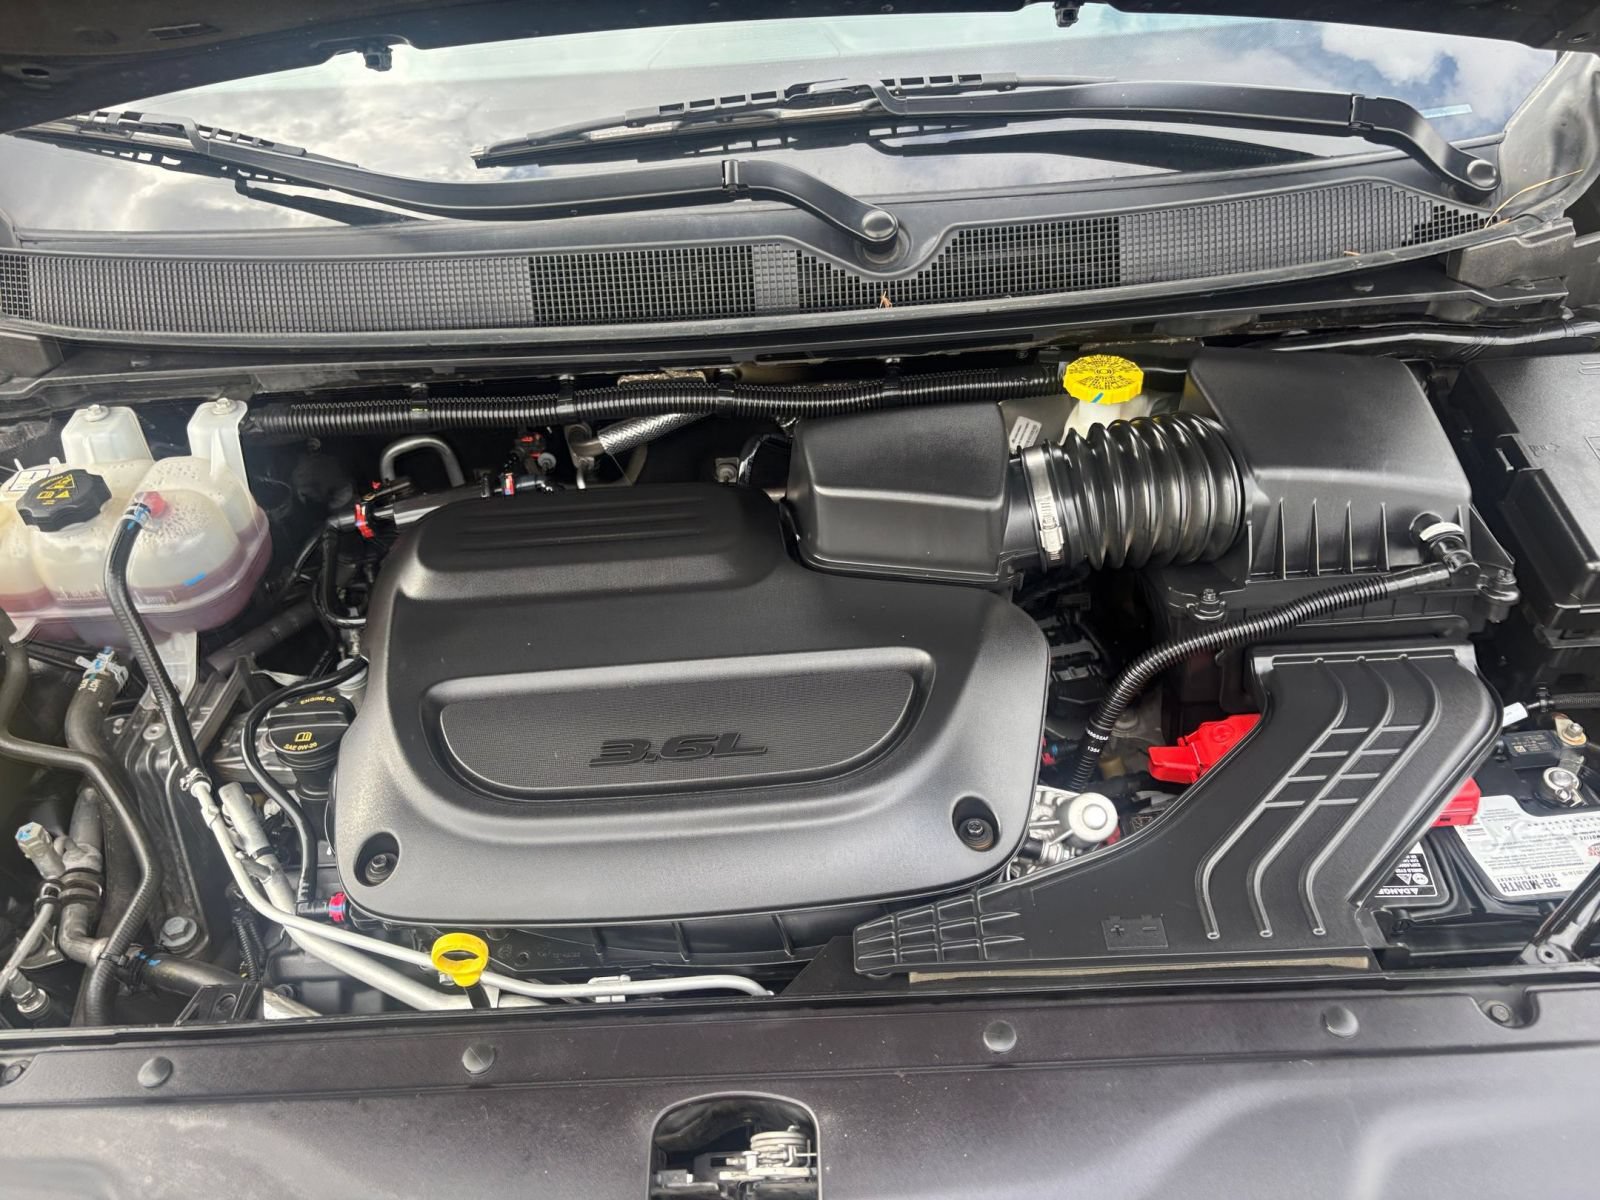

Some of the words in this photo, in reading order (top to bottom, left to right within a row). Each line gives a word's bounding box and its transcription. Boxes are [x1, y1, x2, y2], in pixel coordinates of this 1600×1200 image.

[300, 696, 325, 704] ENGINE
[589, 731, 768, 767] 3.6L
[1499, 877, 1561, 892] 36-MONTH
